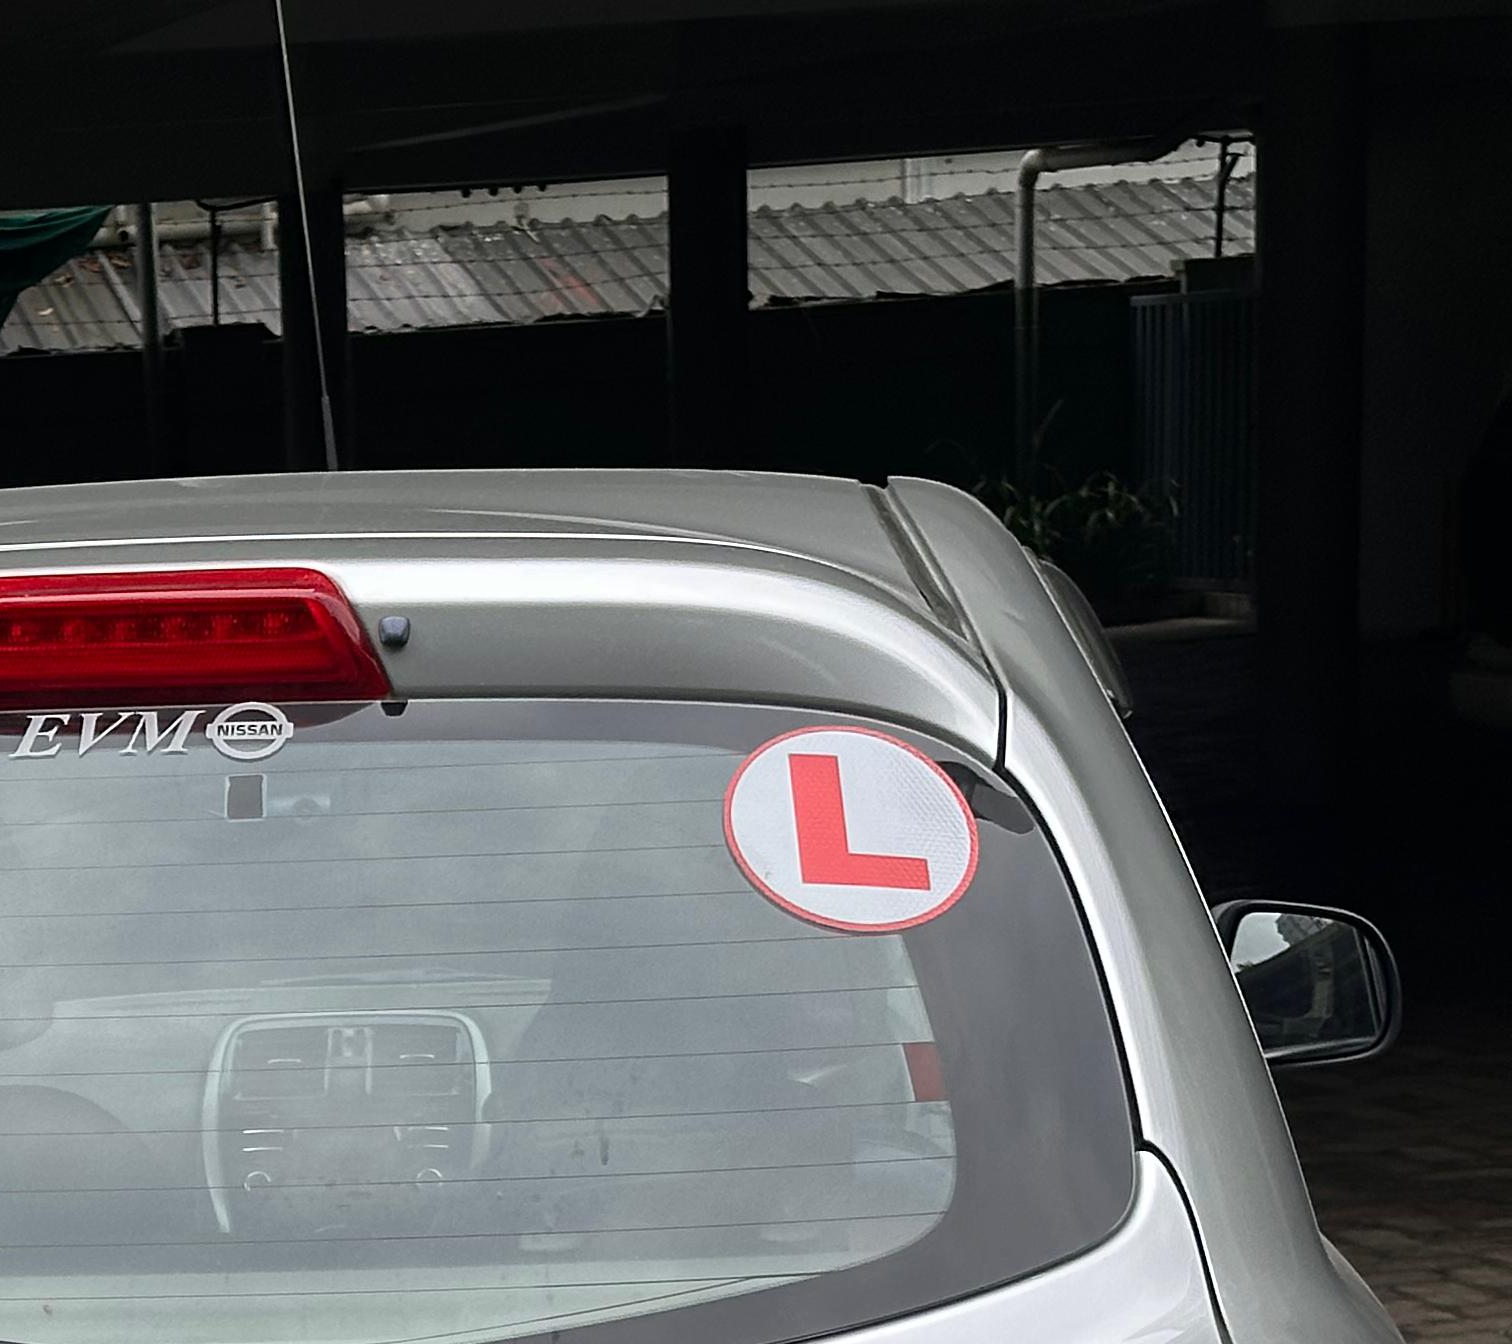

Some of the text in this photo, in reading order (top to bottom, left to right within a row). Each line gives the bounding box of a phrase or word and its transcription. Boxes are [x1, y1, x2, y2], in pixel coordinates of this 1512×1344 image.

[8, 709, 284, 760] EVM NISSAN
[788, 753, 931, 891] L
